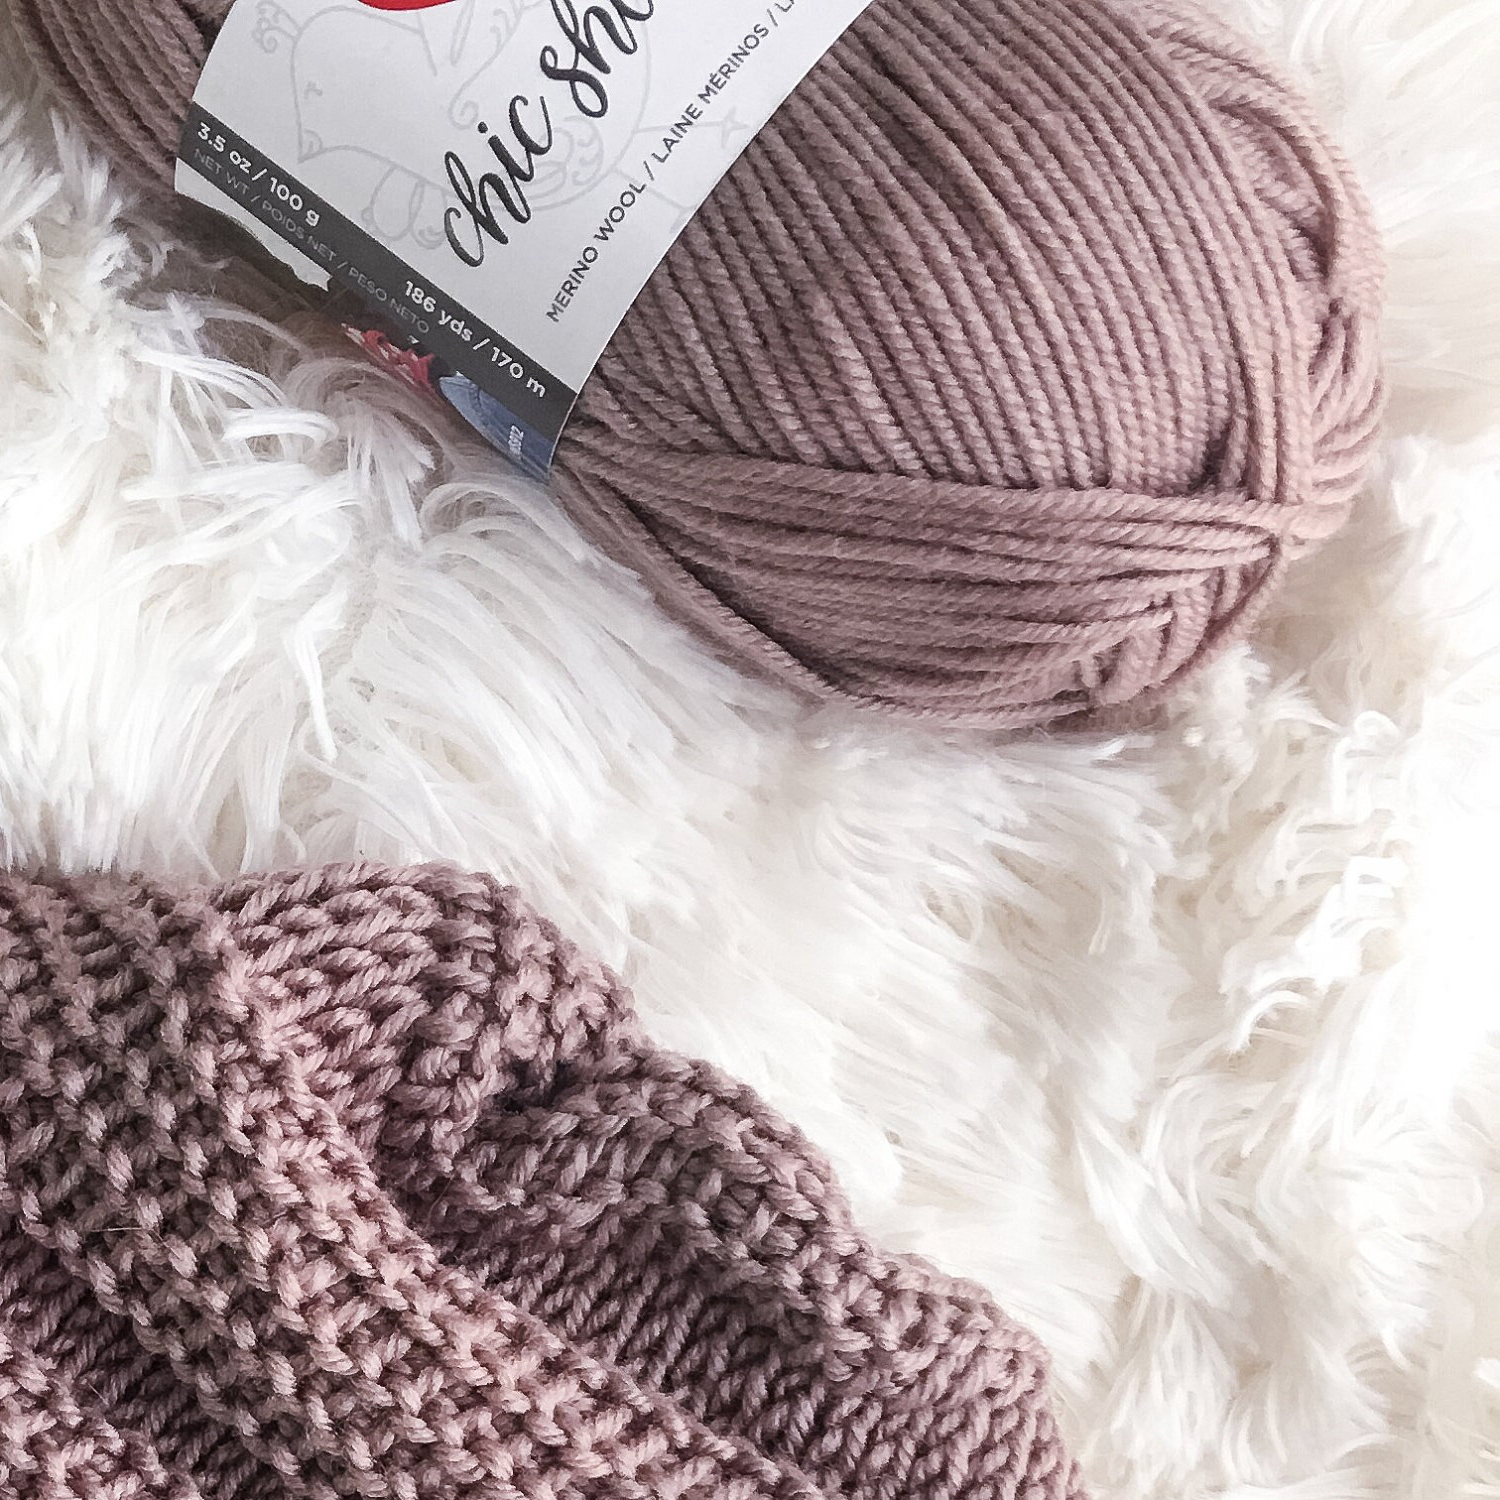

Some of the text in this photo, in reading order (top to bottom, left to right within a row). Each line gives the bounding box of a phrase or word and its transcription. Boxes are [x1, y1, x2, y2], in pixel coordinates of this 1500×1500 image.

[194, 148, 223, 175] NET
[226, 172, 249, 195] WT
[262, 200, 304, 240] POIDS
[307, 236, 338, 262] NET
[349, 266, 388, 301] PESO
[390, 299, 430, 333] NETO
[197, 122, 227, 152] 3.5
[229, 150, 252, 174] oz
[269, 176, 304, 211] 100
[304, 209, 321, 227] g
[444, 95, 552, 267] chic
[546, 245, 599, 323] MERINO
[594, 182, 646, 242] WOOL
[651, 103, 703, 163] LAINE
[697, 23, 770, 105] MÉRINOS
[404, 280, 437, 313] 186
[437, 309, 473, 342] yds
[490, 346, 524, 380] 170
[525, 377, 547, 398] m
